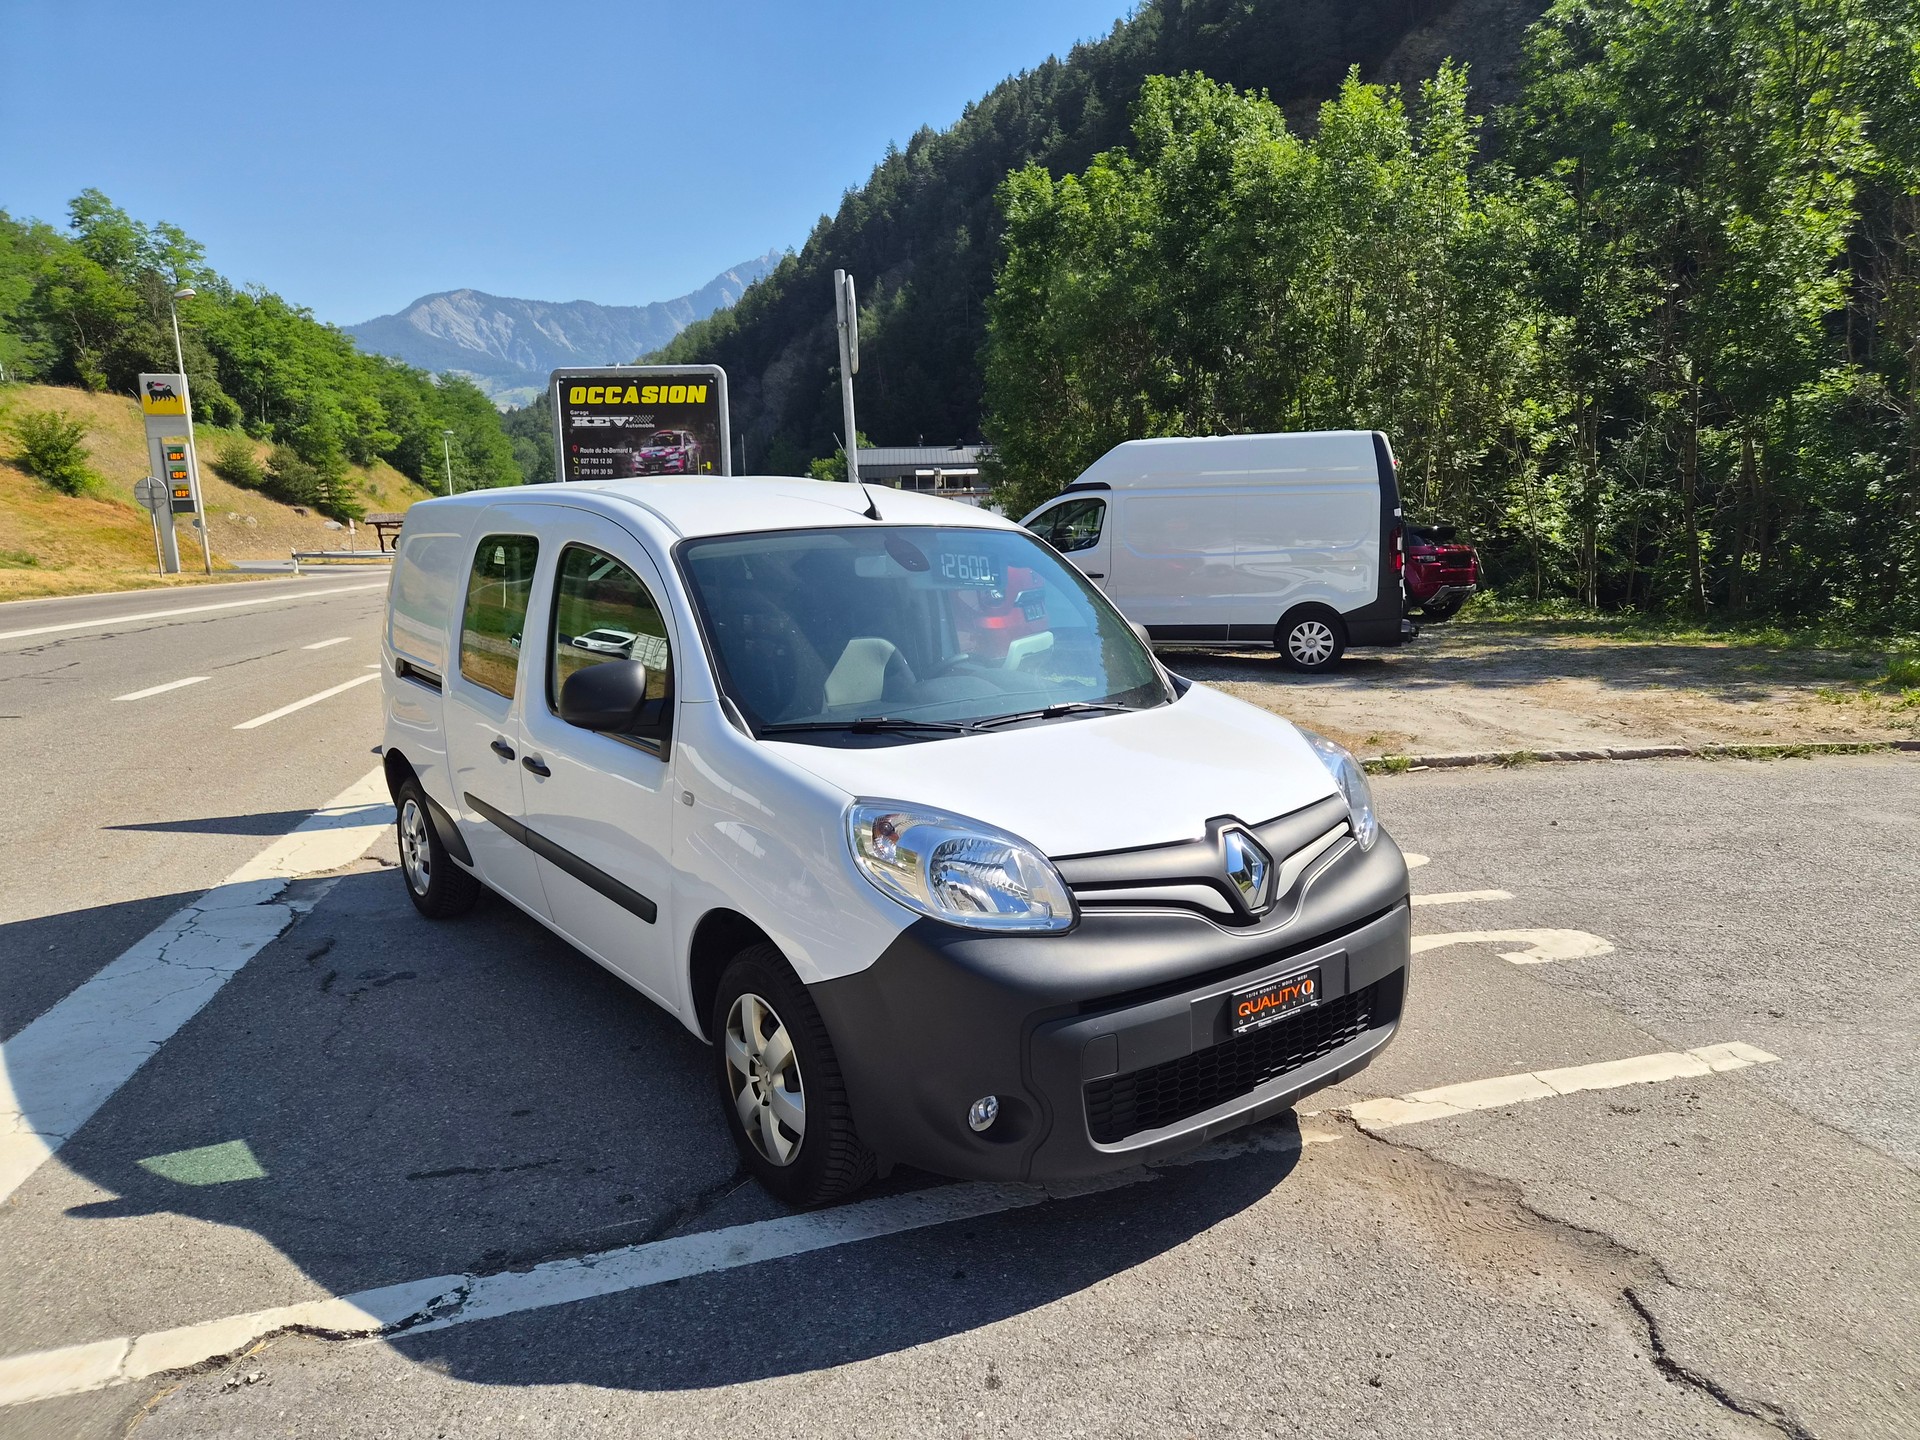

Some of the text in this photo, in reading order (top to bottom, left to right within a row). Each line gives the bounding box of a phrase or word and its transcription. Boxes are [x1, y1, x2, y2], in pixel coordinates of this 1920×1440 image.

[569, 385, 708, 405] OCCASION
[1238, 984, 1301, 1017] QUALITY
[1239, 994, 1314, 1025] GARANTIE
